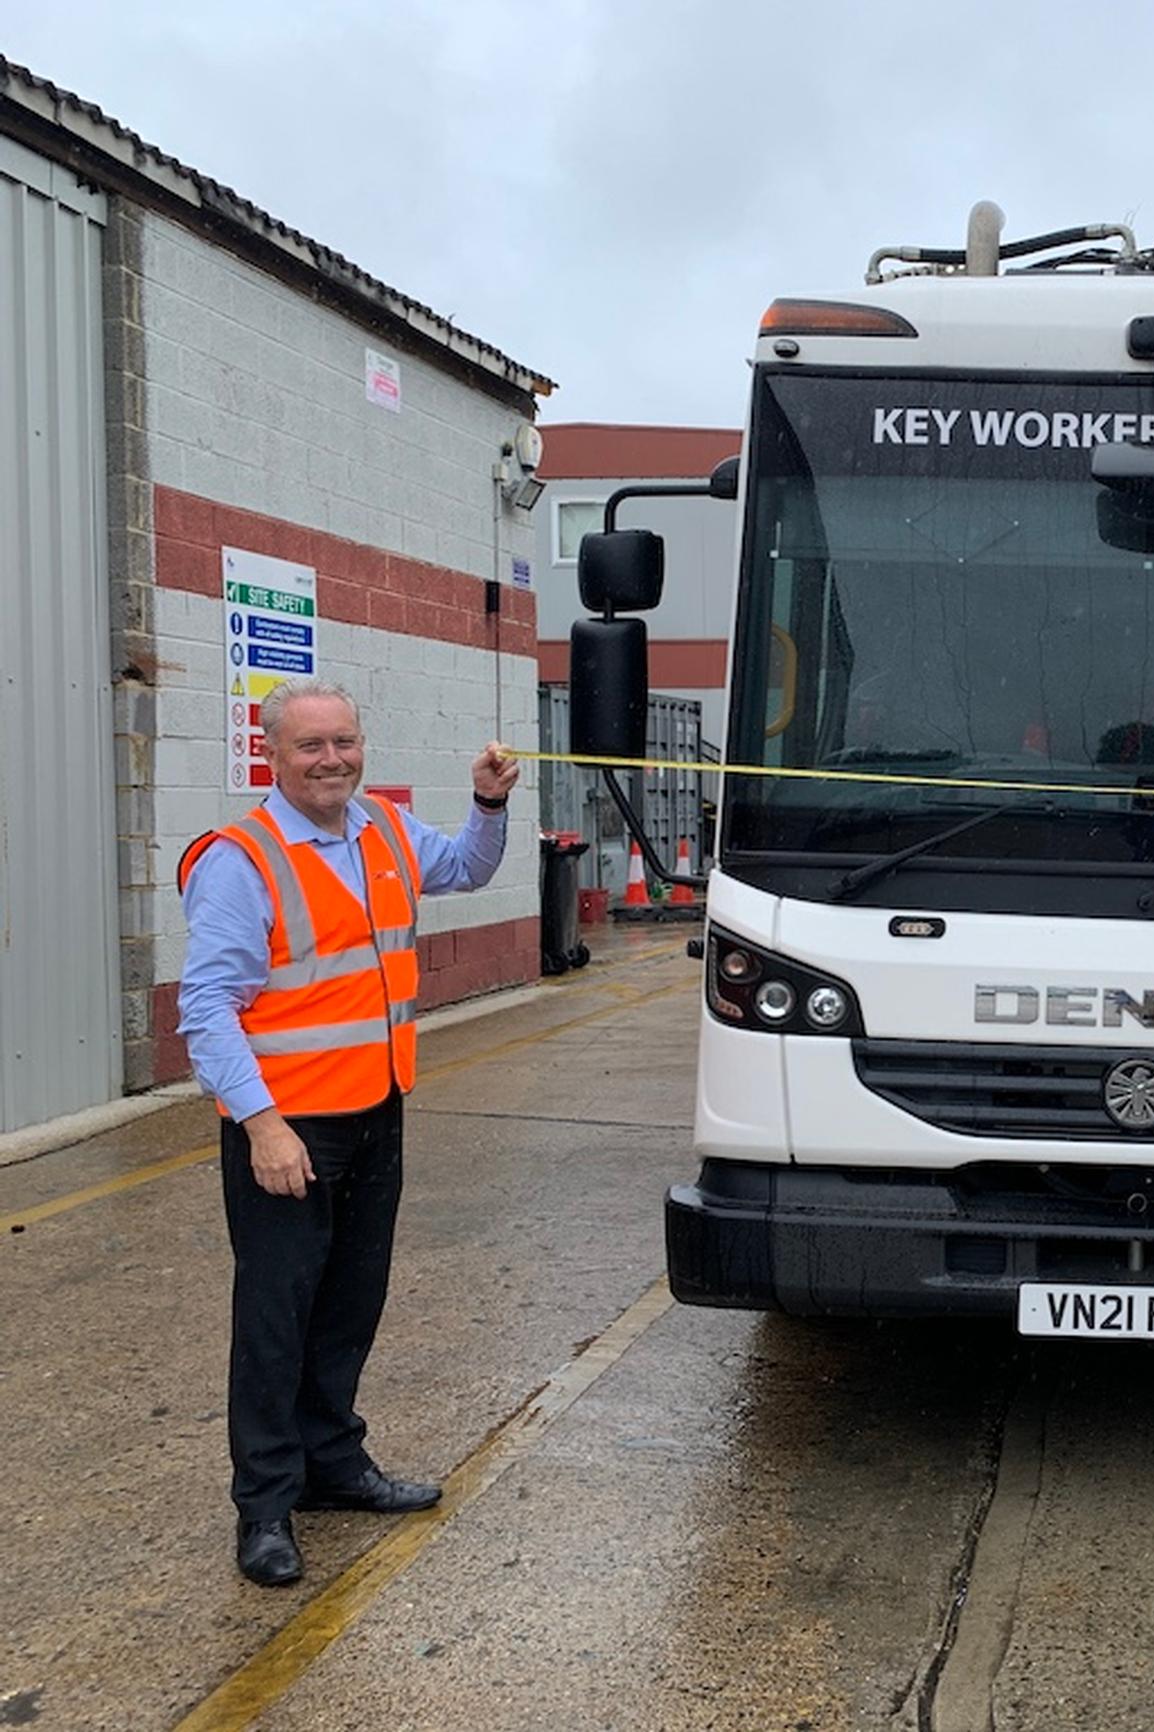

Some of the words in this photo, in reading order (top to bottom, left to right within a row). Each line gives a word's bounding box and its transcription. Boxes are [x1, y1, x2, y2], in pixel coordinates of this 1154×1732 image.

[873, 408, 961, 445] KEY
[247, 587, 269, 606] SITE
[272, 592, 305, 613] SAFETY
[1047, 1292, 1134, 1331] VN21
